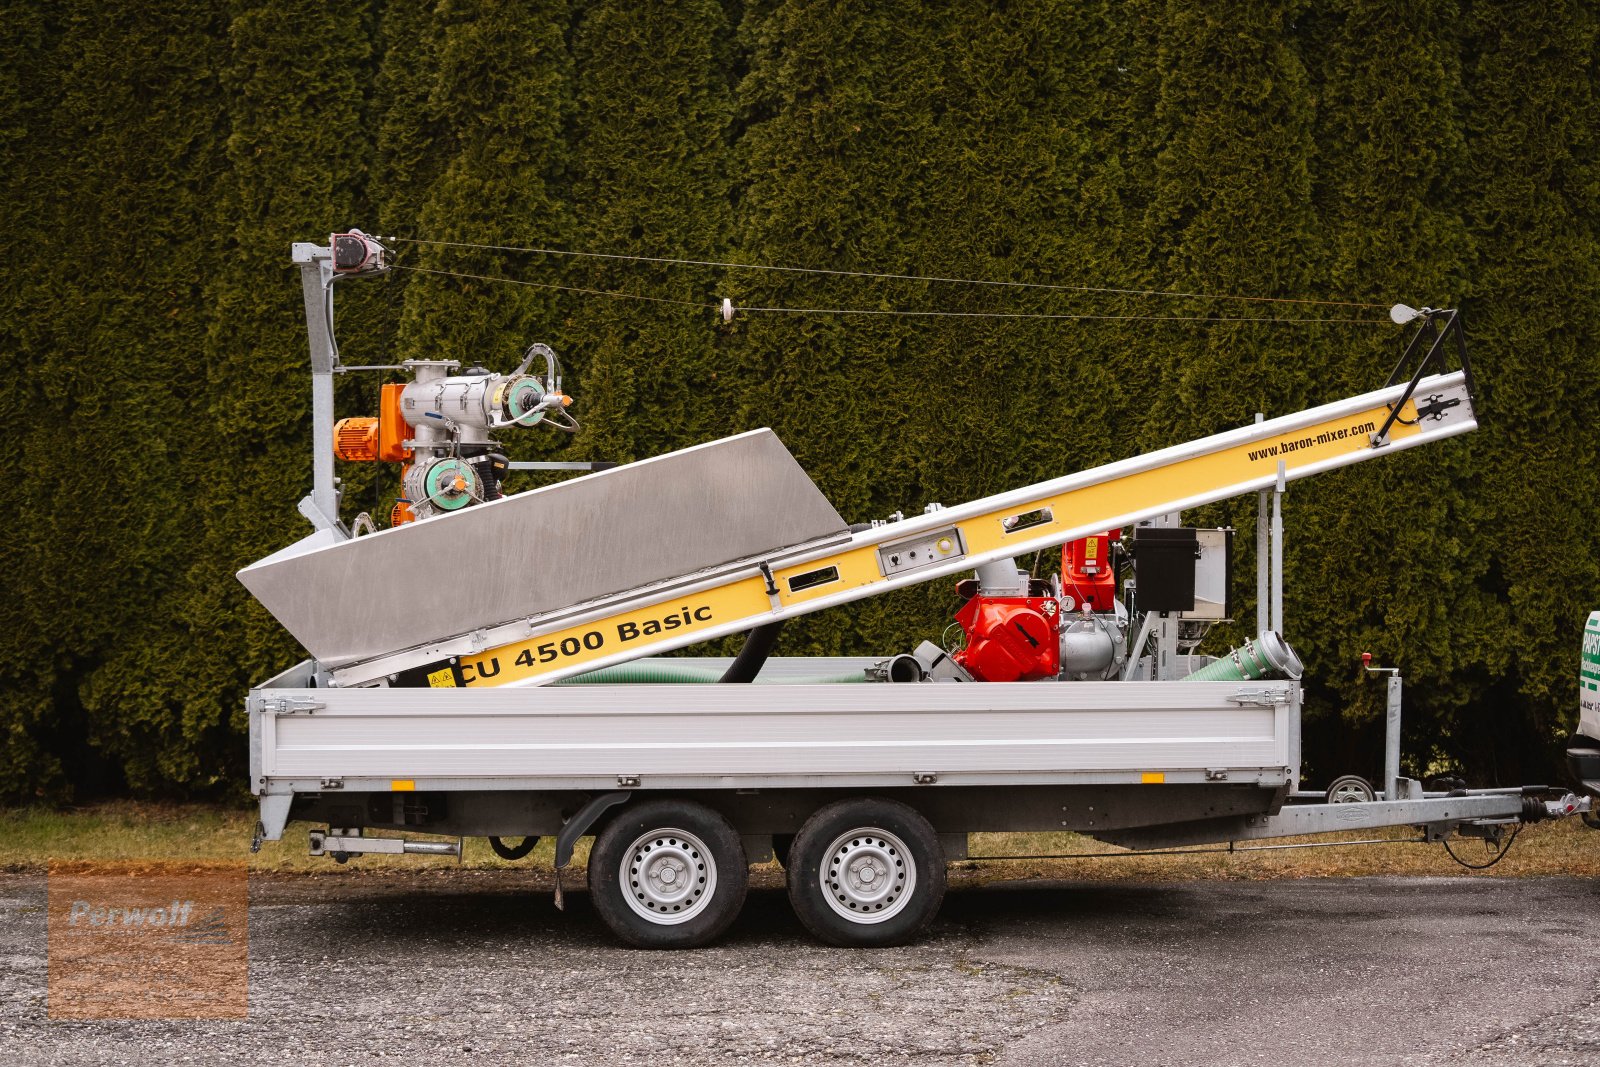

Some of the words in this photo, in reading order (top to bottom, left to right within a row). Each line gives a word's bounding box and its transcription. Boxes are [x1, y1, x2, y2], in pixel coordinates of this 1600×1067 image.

[1248, 422, 1376, 461] www.baron-mixer.com
[514, 631, 604, 667] 4500
[617, 606, 713, 642] Basic
